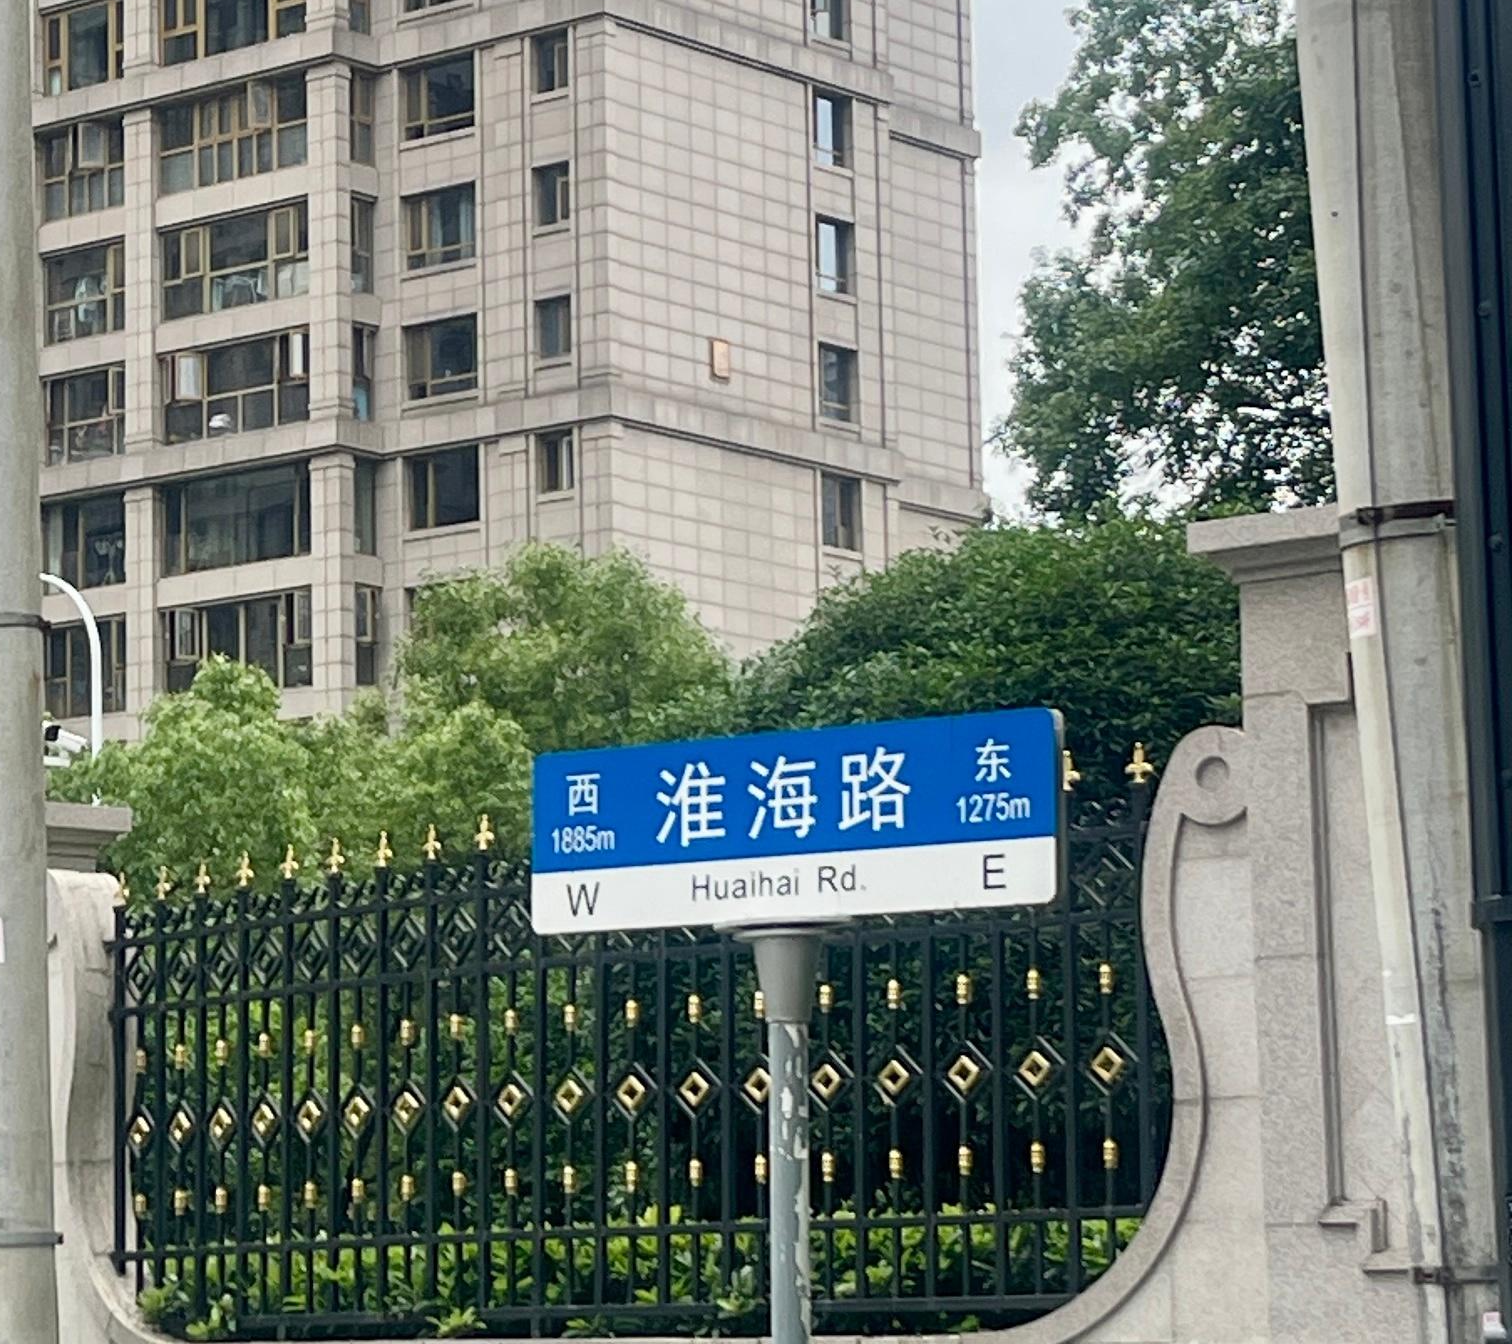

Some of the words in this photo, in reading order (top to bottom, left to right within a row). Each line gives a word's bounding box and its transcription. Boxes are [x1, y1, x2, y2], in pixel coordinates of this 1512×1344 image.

[974, 738, 1011, 783] 东
[565, 773, 601, 816] 西
[655, 746, 912, 847] 淮海路
[956, 792, 1030, 824] 1275m
[551, 825, 616, 854] 1885m
[691, 871, 800, 901] Huaihai
[817, 864, 867, 893] Rd.
[982, 853, 1006, 891] E
[566, 882, 601, 917] W
